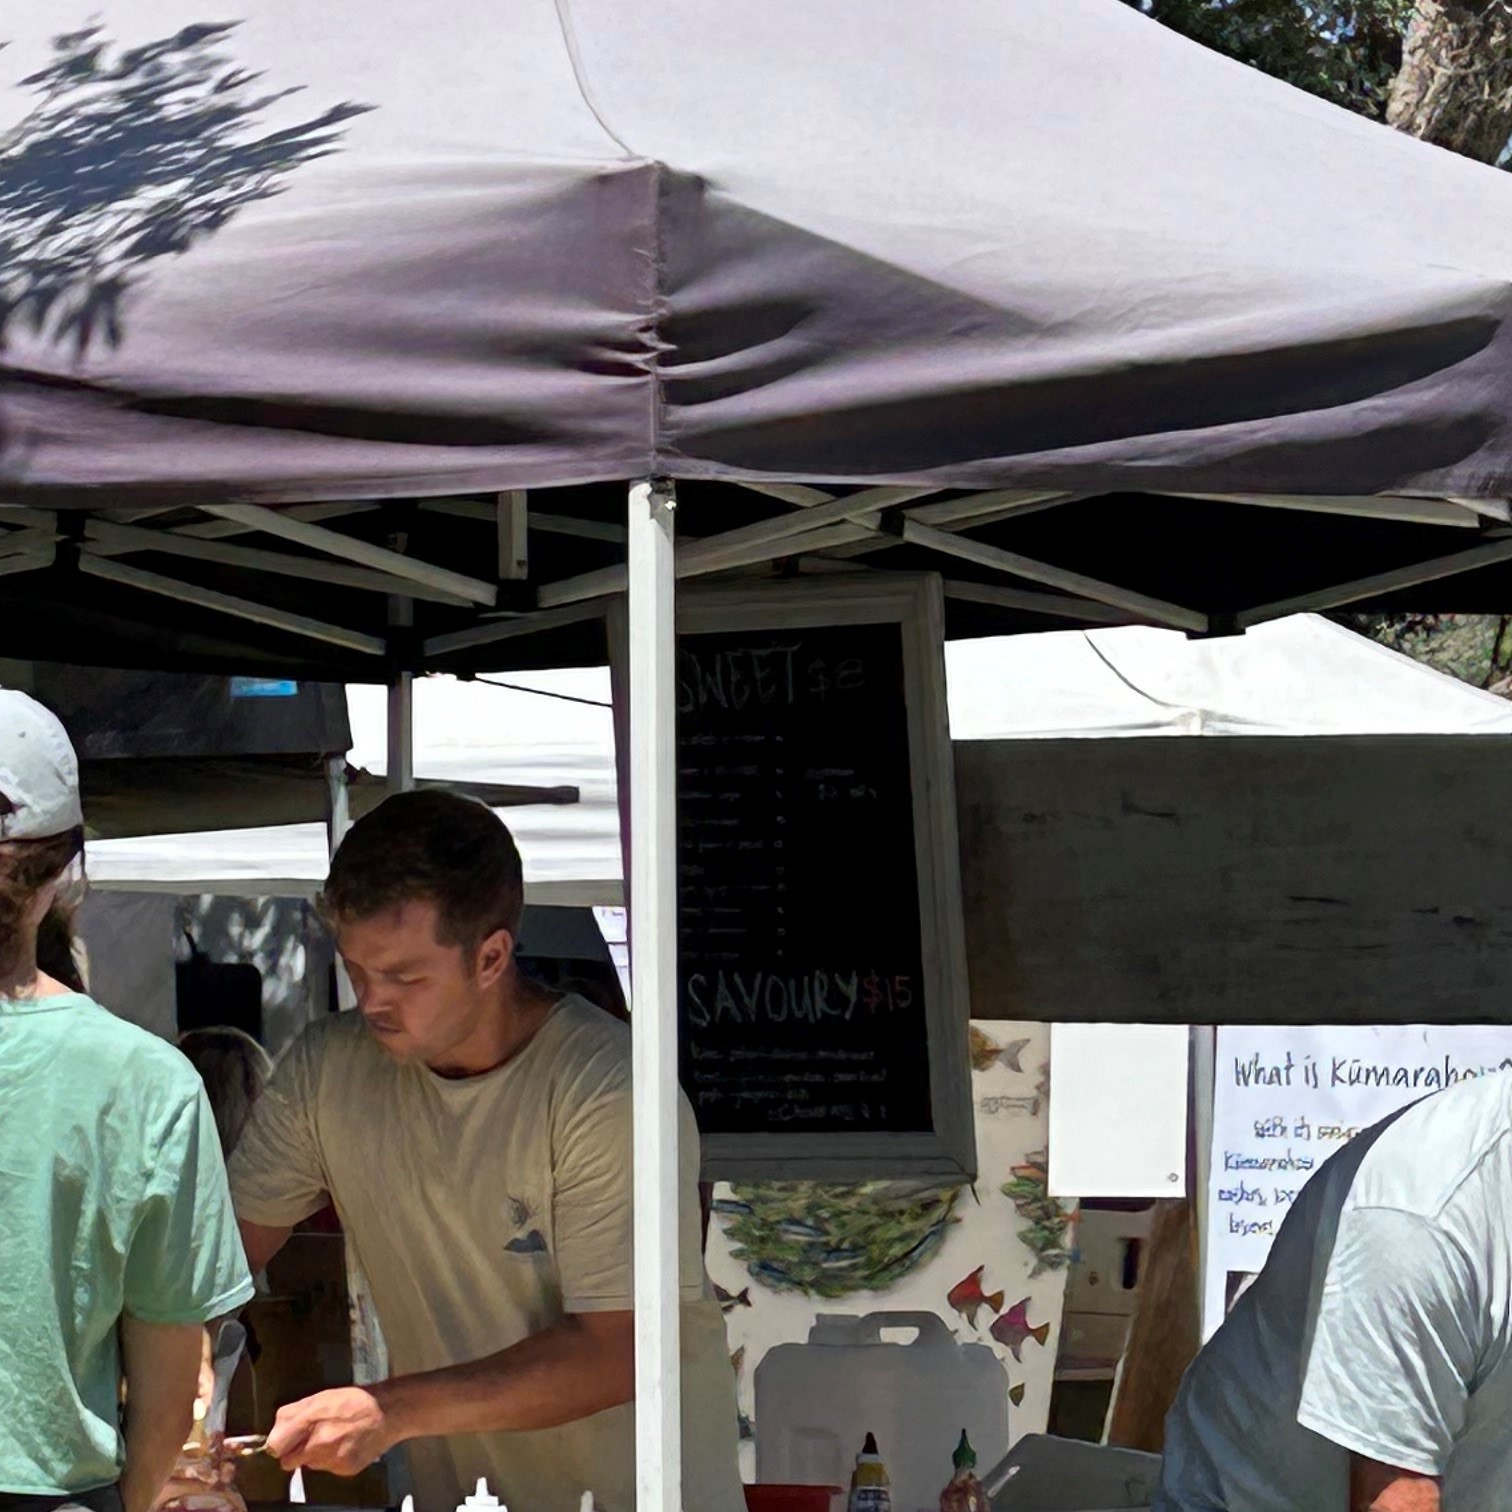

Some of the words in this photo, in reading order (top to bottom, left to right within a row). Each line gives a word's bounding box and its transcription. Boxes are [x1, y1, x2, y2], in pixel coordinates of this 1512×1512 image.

[687, 968, 859, 1028] SAVOURY
[861, 966, 913, 1016] $15
[1234, 1051, 1294, 1087] What
[1304, 1055, 1319, 1089] is
